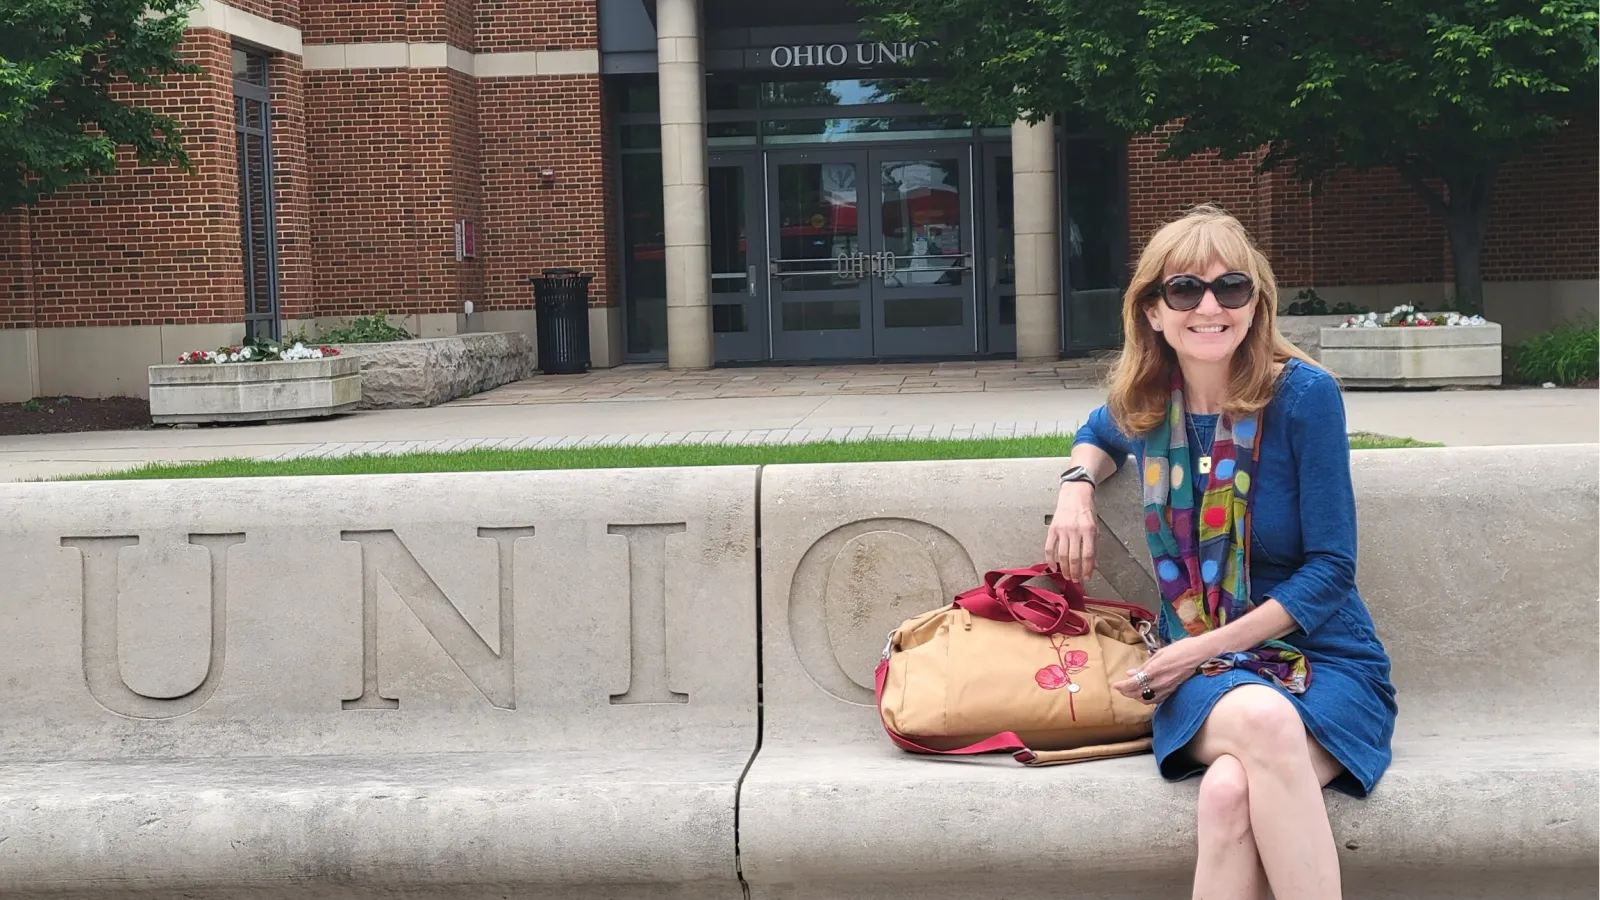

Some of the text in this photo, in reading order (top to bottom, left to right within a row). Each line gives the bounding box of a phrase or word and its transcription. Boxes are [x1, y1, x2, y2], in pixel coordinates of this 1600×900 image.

[770, 40, 939, 67] OHIO UNIO
[837, 251, 896, 279] OHIO
[60, 514, 1160, 721] UNIO
